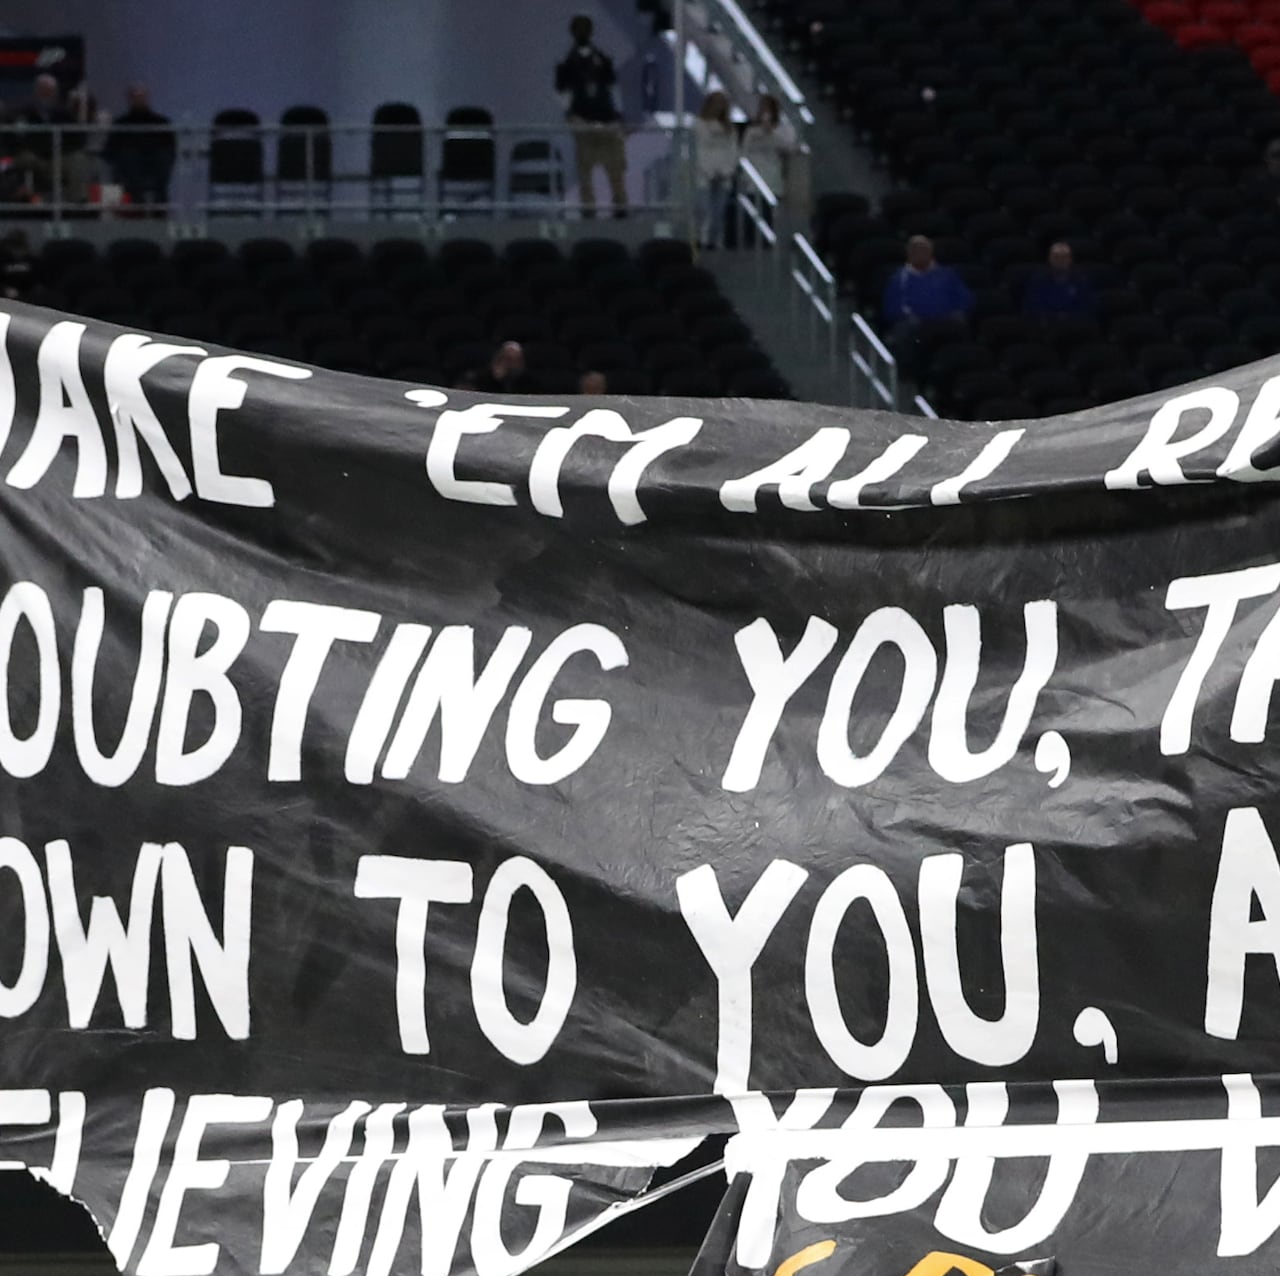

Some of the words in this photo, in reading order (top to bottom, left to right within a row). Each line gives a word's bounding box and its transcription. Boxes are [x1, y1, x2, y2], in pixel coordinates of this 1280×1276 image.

[721, 599, 1072, 793] YOU,
[353, 855, 577, 1066] TO
[675, 842, 1118, 1096] YOU,
[723, 1079, 1100, 1269] YOU
